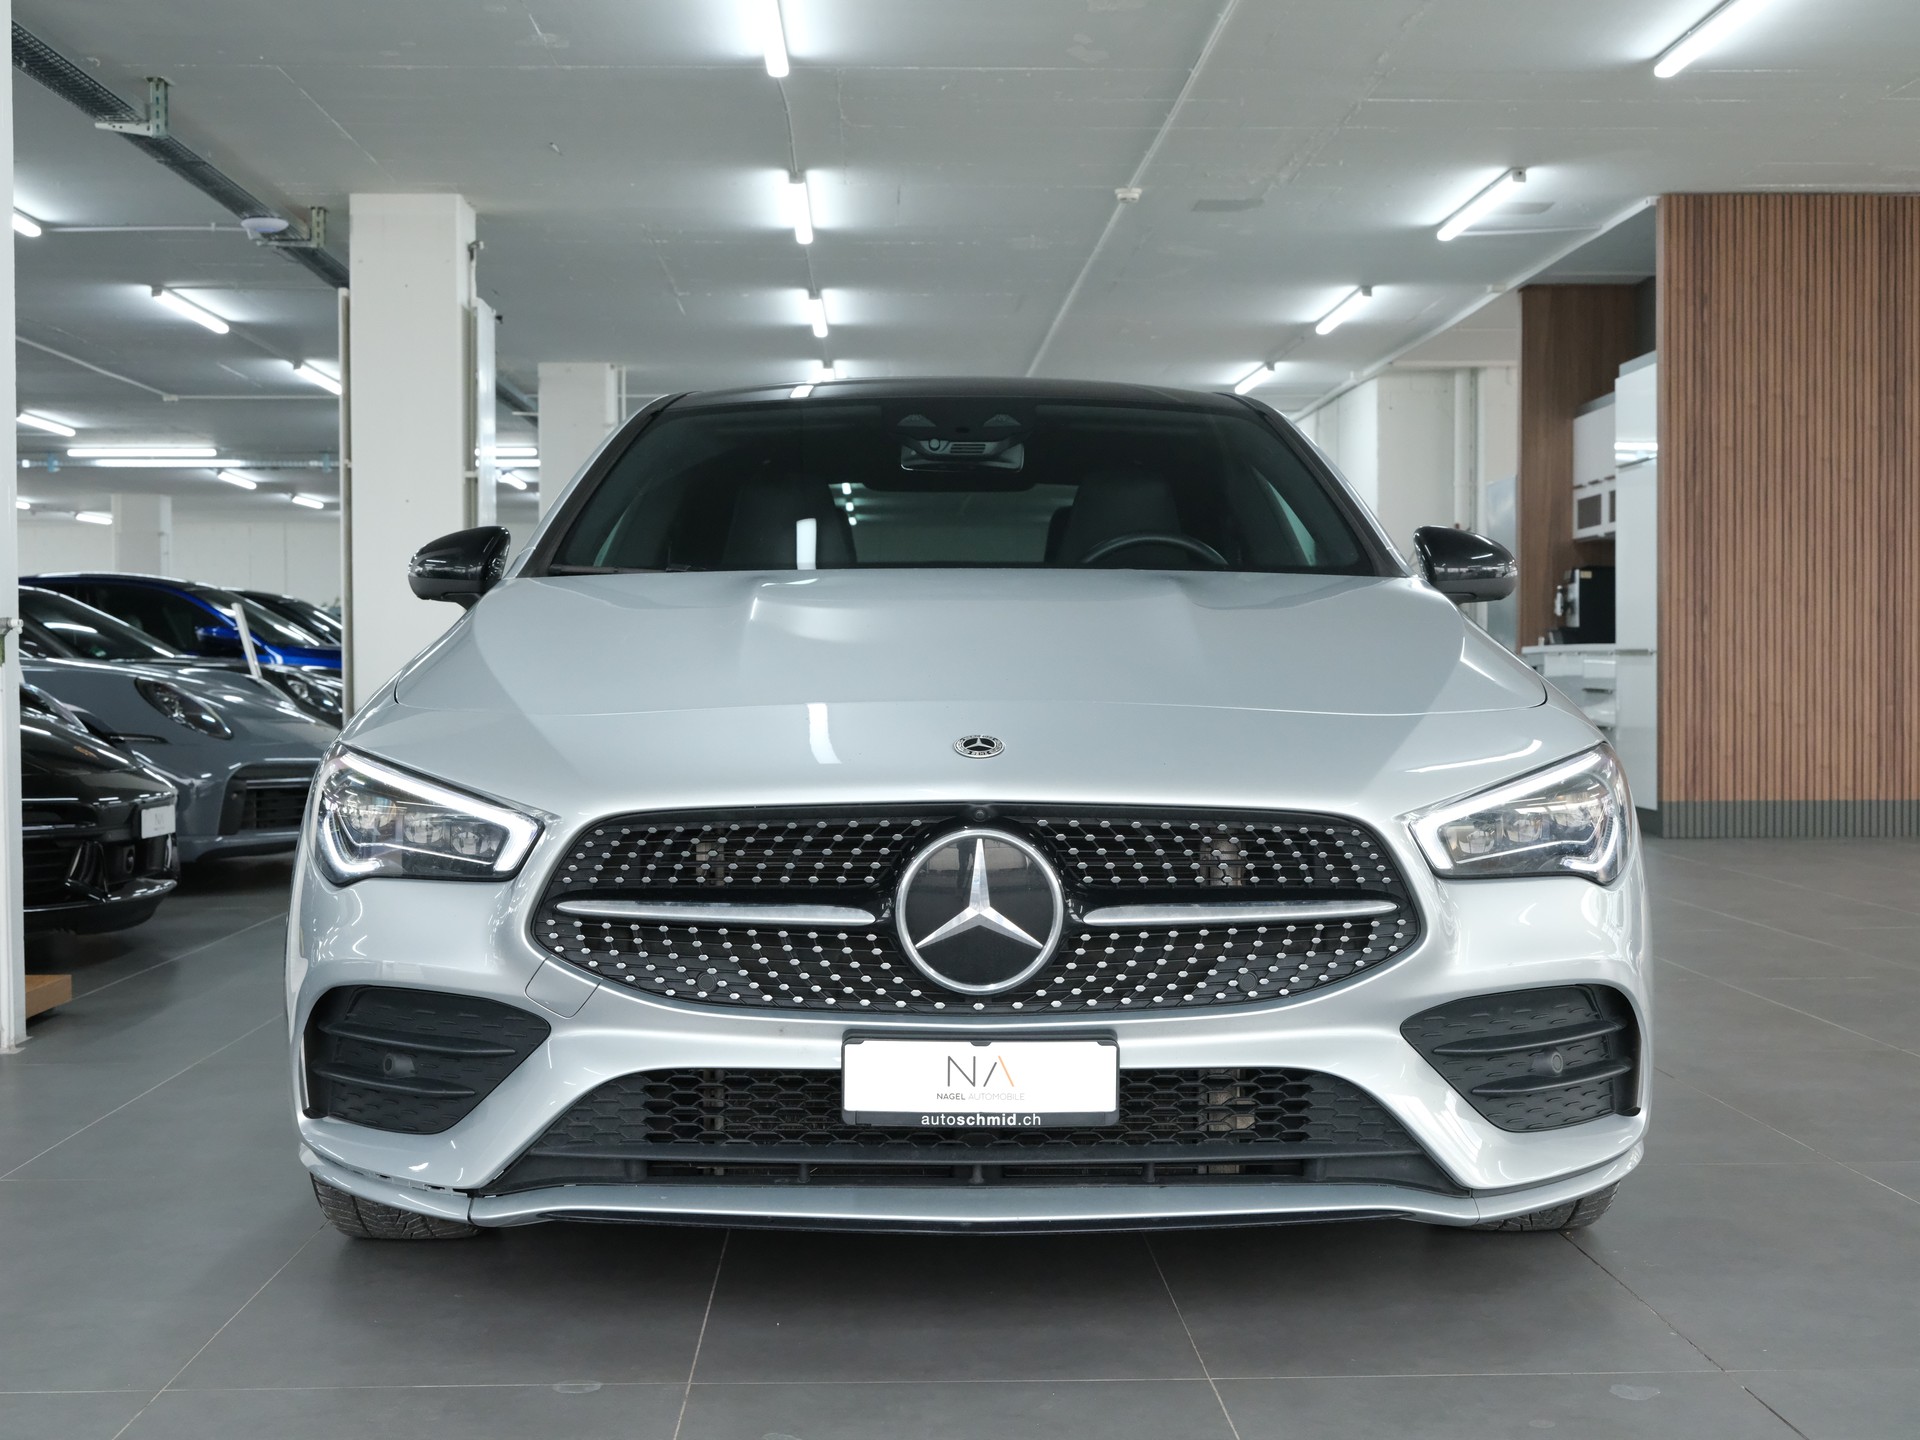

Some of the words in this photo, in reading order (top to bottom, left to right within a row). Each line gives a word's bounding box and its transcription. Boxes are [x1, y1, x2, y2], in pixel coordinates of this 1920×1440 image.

[947, 1055, 1014, 1087] NA
[936, 1092, 966, 1101] NAGEL
[968, 1092, 1025, 1101] AUTOMOBILE
[921, 1113, 1041, 1126] autoschmid.ch
